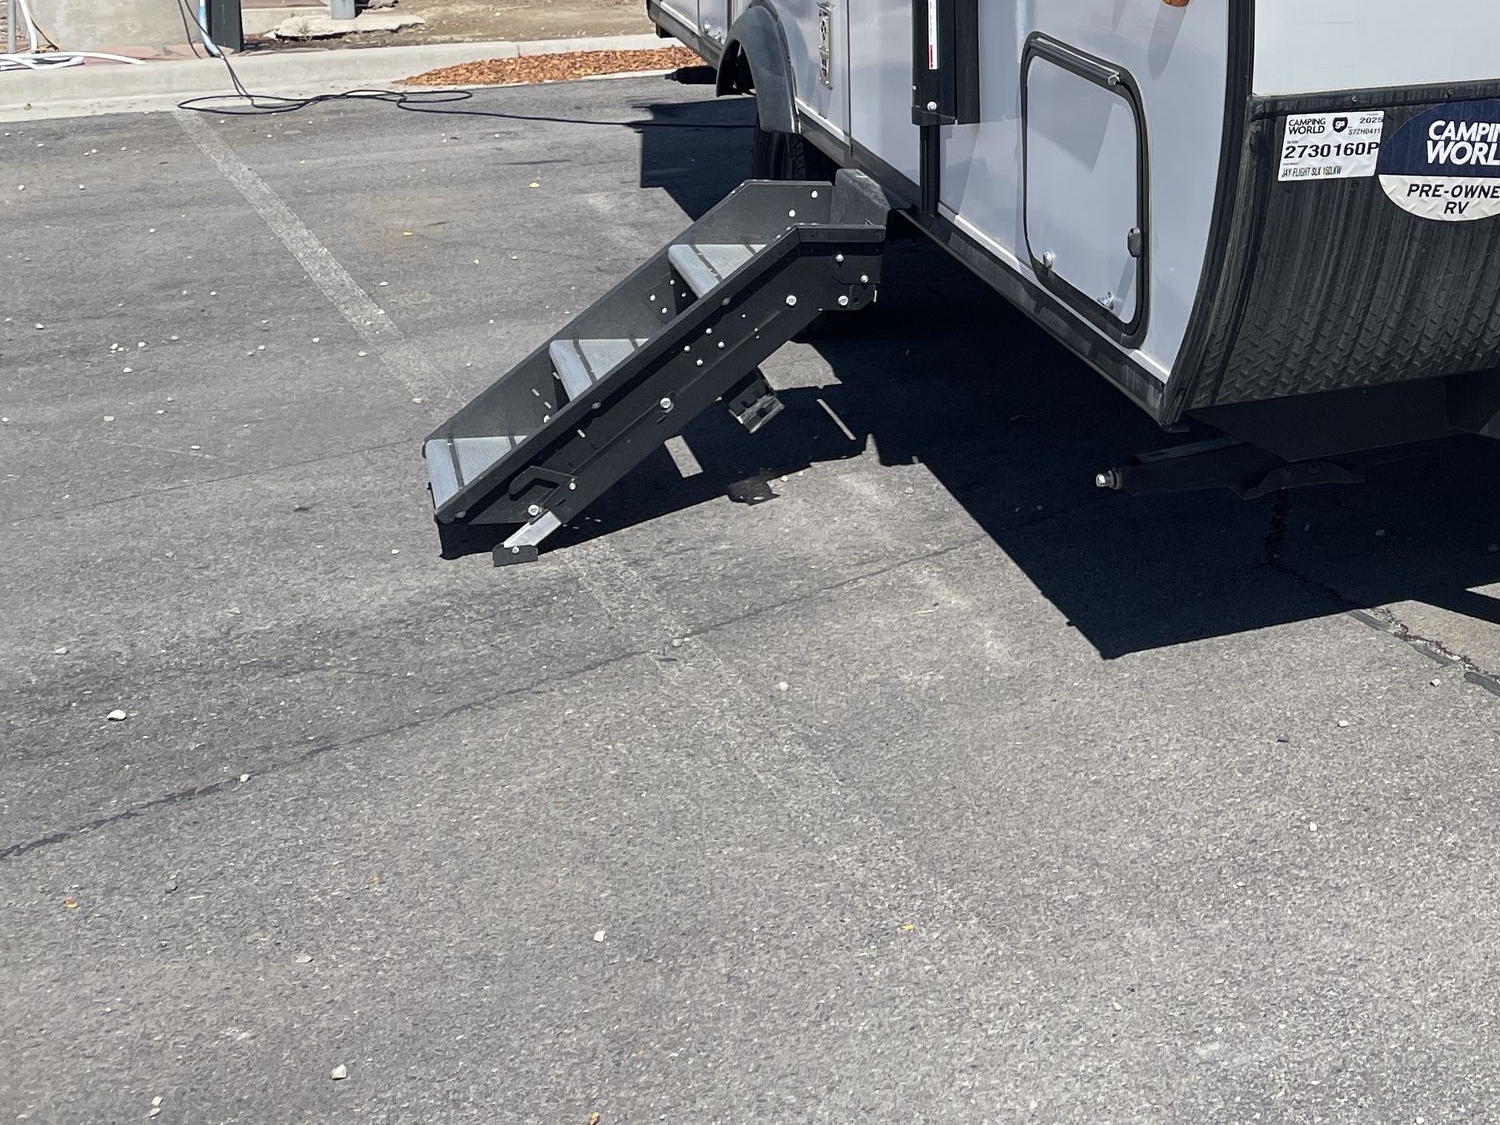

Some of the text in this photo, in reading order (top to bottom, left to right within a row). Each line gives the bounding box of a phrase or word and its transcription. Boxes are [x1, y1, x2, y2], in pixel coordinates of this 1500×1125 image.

[1288, 118, 1326, 127] CAMPING
[1360, 116, 1384, 124] 2025
[1288, 125, 1326, 135] WORLD
[1283, 141, 1381, 159] 2730160P
[1443, 201, 1470, 215] RV
